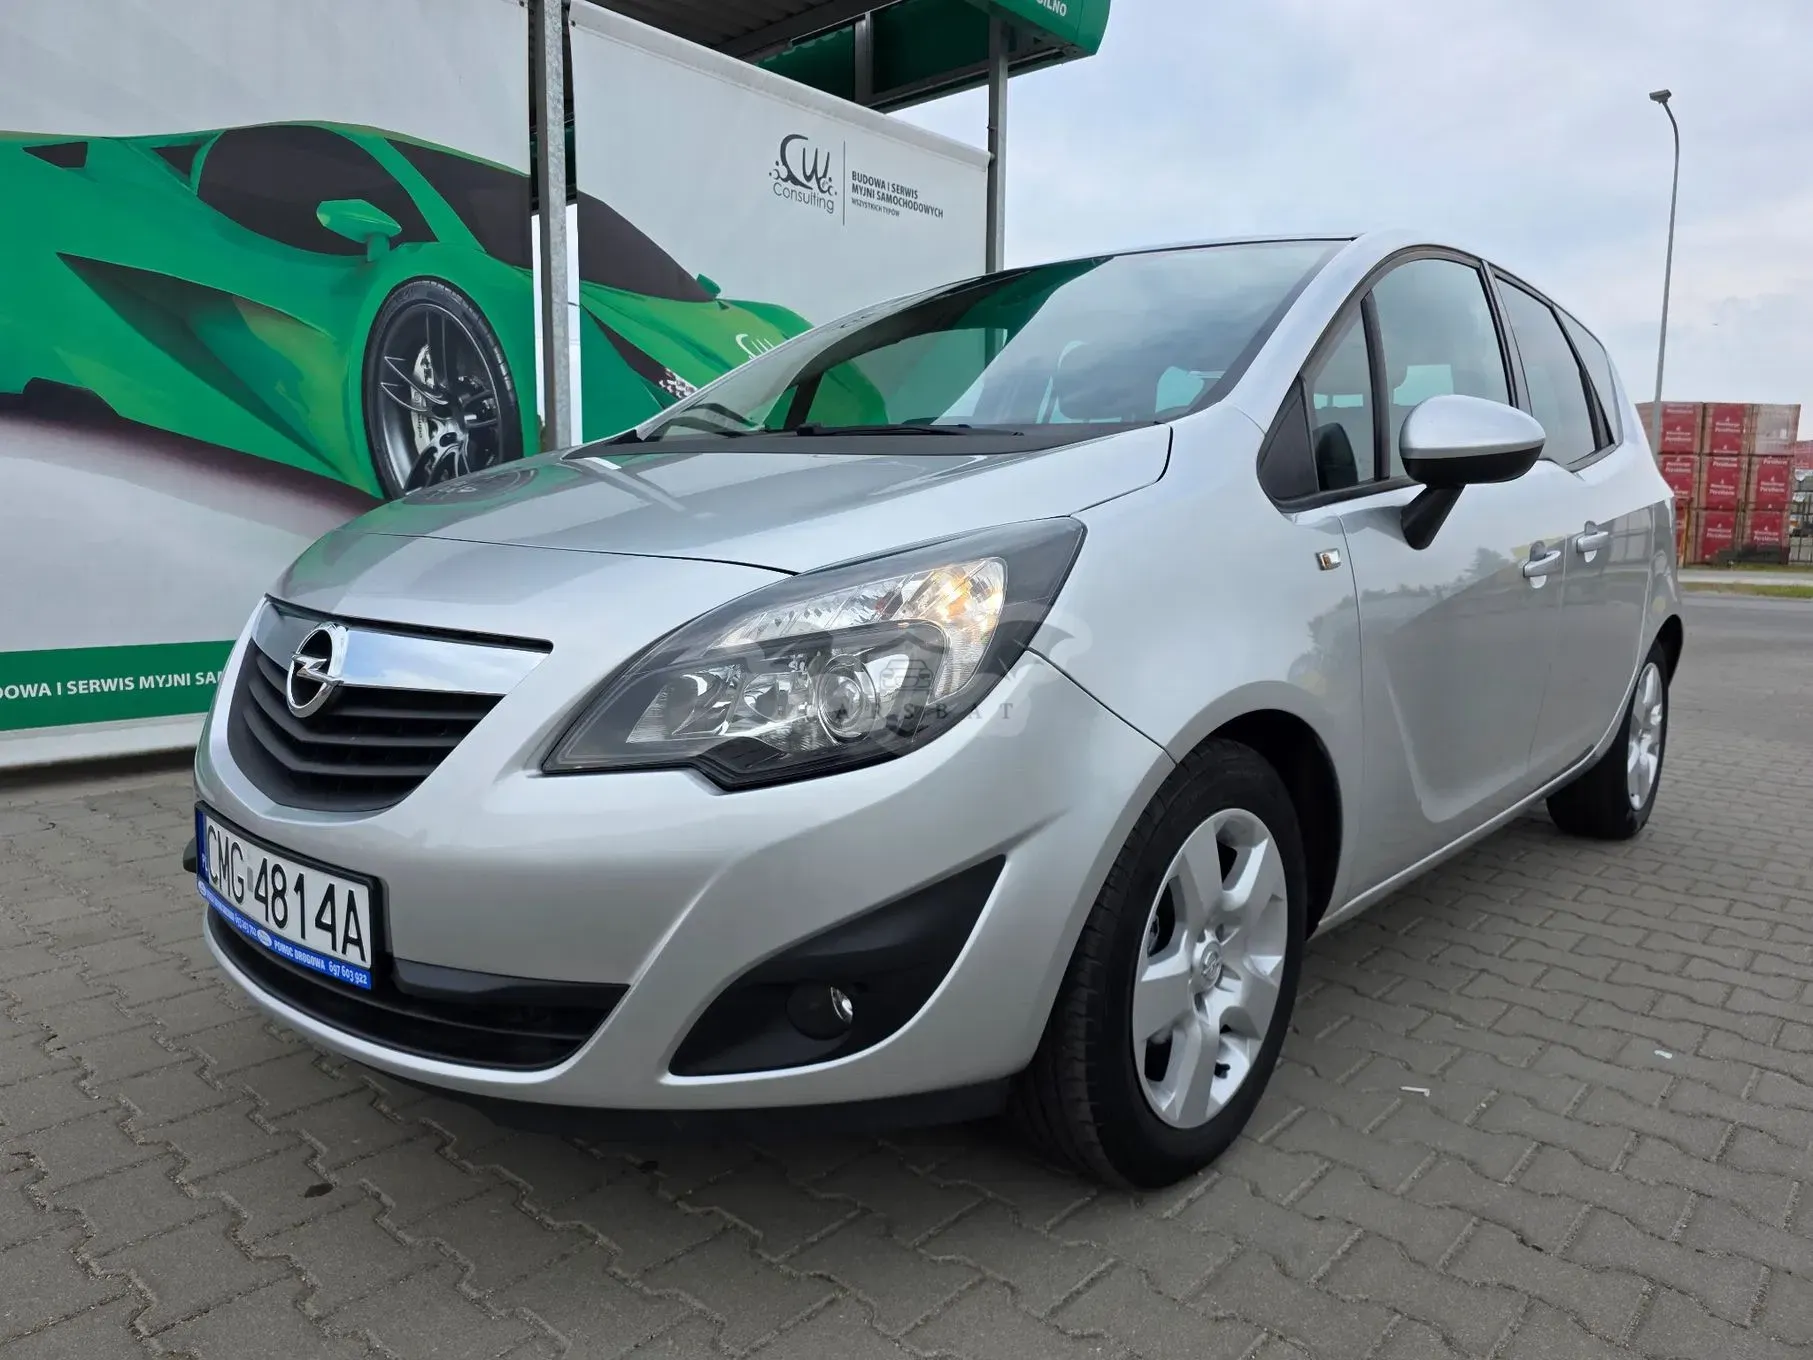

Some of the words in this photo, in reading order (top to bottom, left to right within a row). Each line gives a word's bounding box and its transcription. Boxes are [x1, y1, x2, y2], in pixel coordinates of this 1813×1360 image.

[773, 182, 834, 214] Consulting
[852, 170, 886, 191] BUDOWA
[891, 183, 918, 200] SERWIS
[852, 183, 875, 199] MYJNI
[876, 190, 943, 218] SAMOCHODOWYCH
[0, 683, 52, 699] OWA
[57, 682, 61, 696] I
[67, 676, 135, 695] SERWIS
[139, 673, 191, 690] MYJNI
[207, 824, 245, 905] CMG
[254, 857, 367, 963] 4814A
